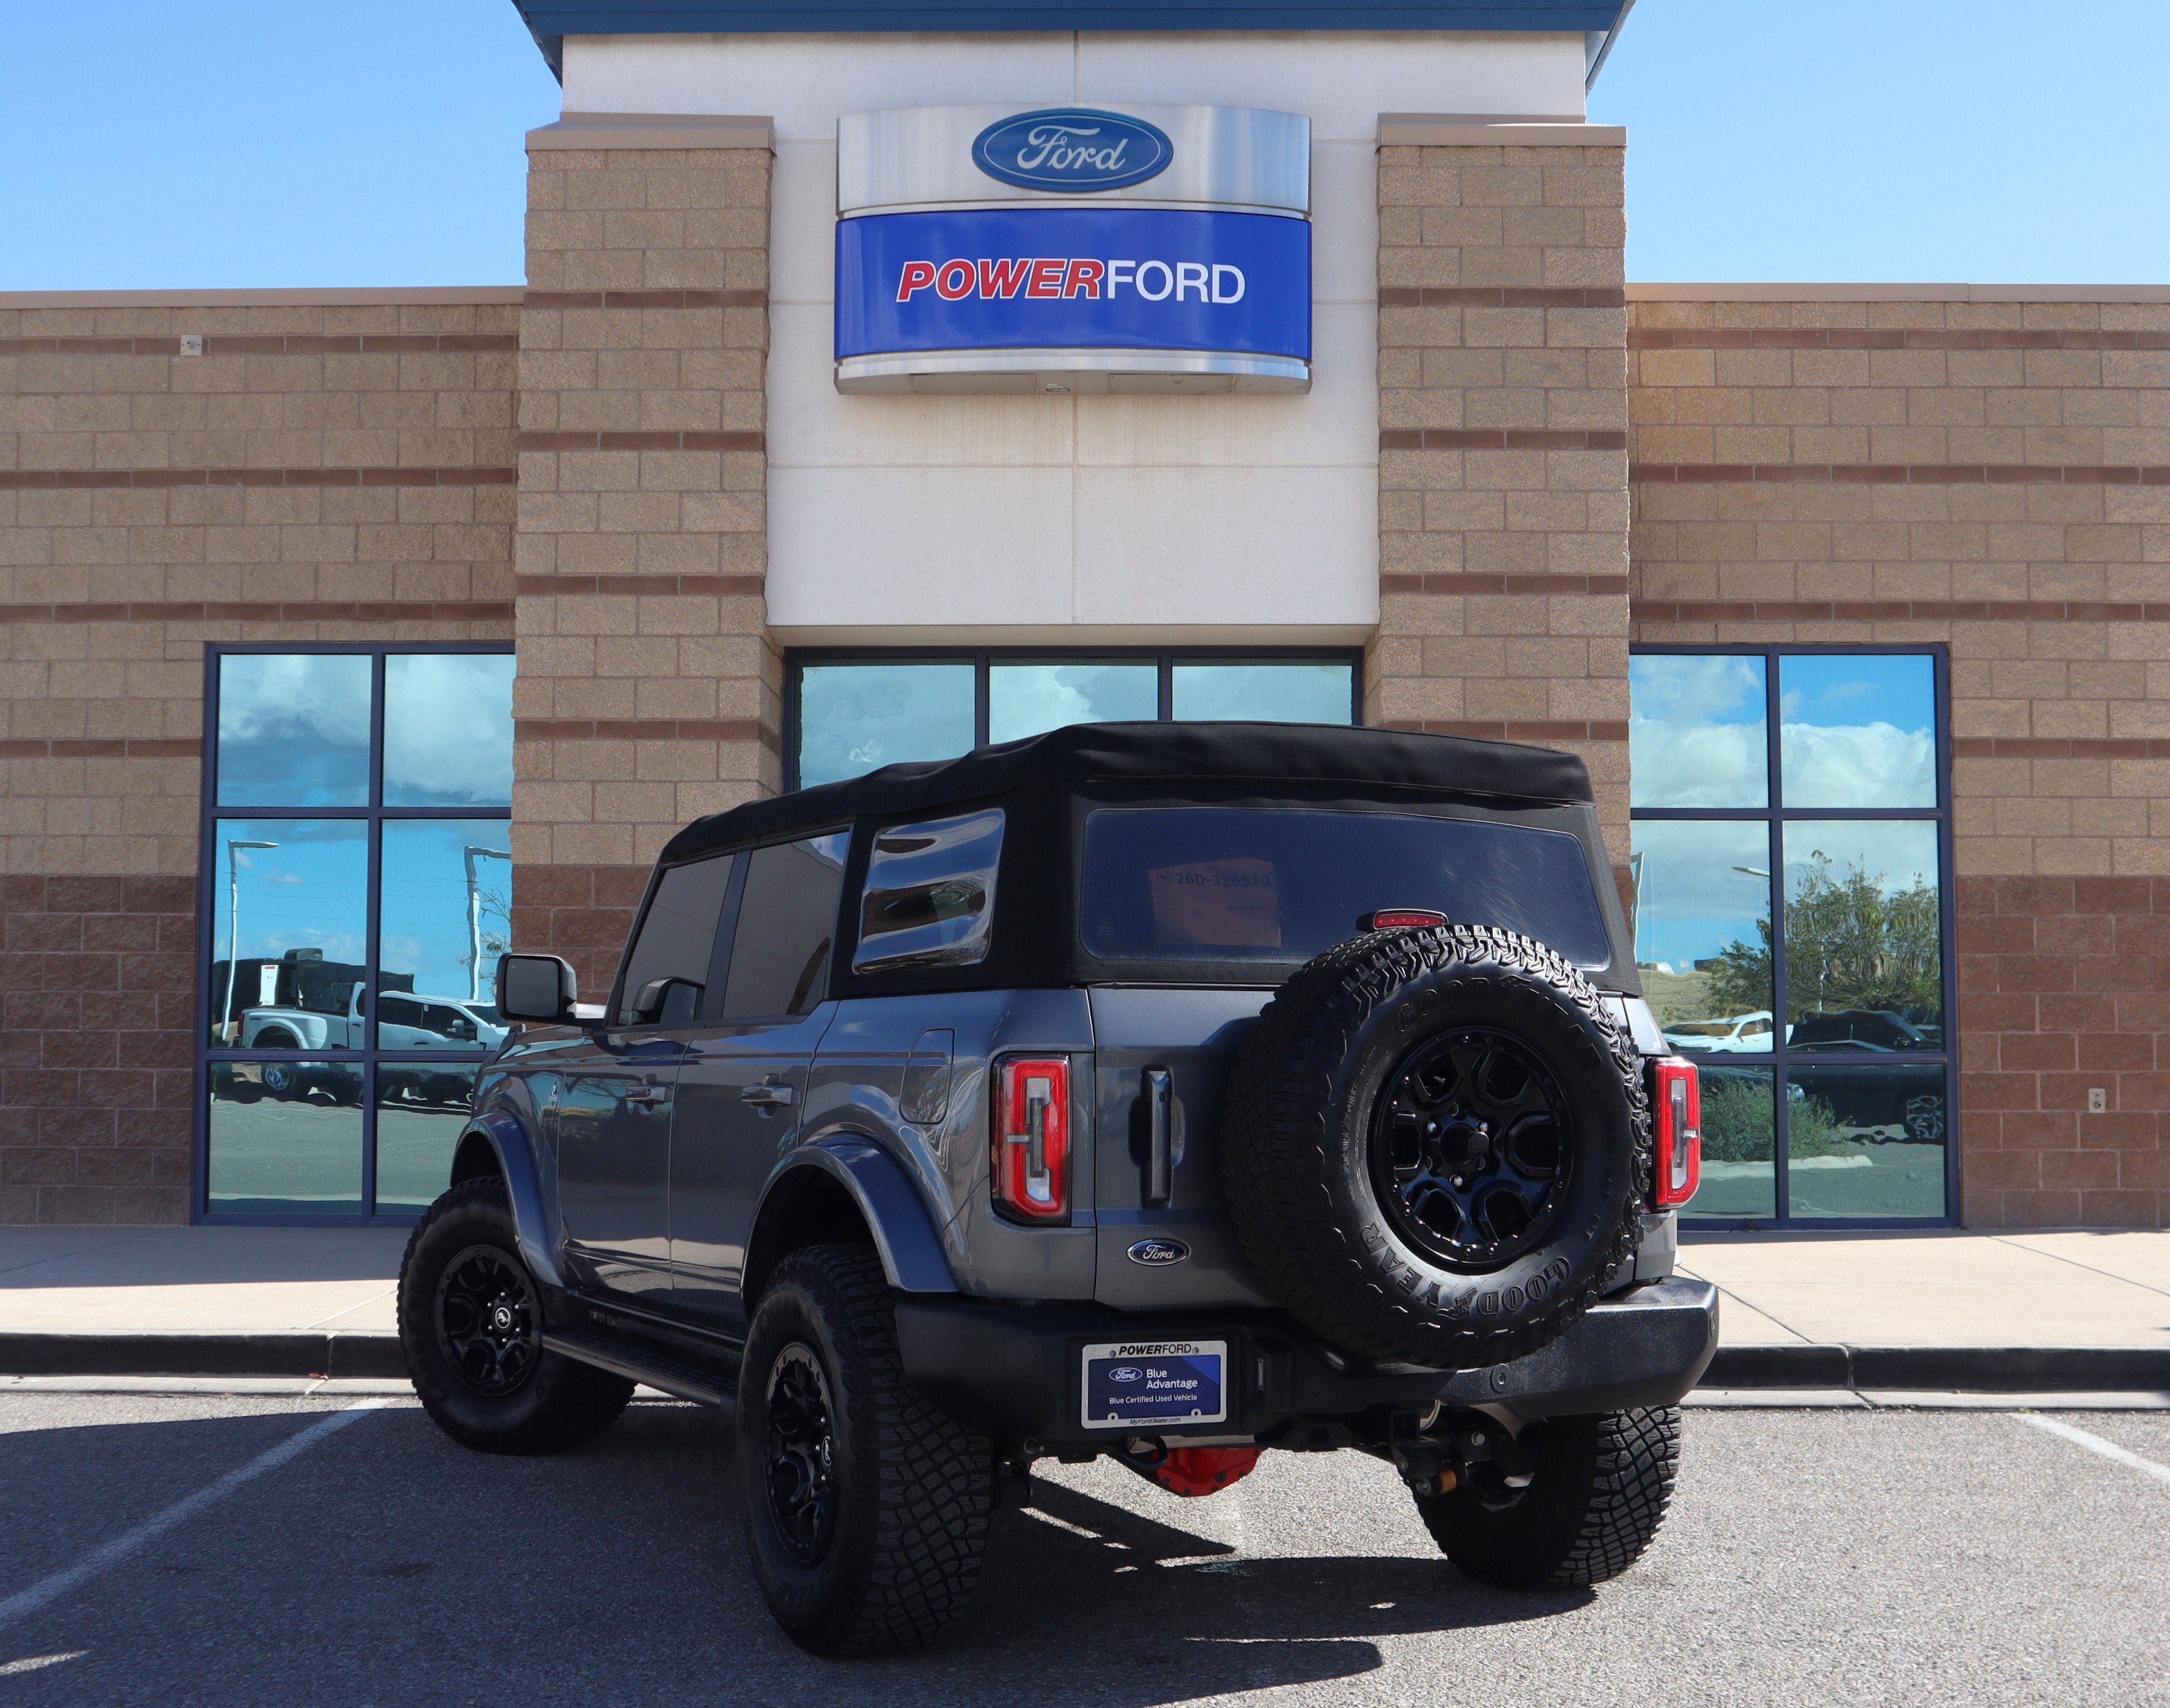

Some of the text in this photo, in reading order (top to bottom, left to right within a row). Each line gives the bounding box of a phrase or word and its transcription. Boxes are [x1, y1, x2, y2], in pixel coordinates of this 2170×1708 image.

[1016, 124, 1129, 170] Ford
[896, 258, 1246, 304] POWERFORD
[1143, 1244, 1174, 1259] Ford
[1360, 1222, 1571, 1319] GOODYEAR
[1118, 1344, 1192, 1355] POWERFORD
[1115, 1369, 1136, 1379] Ford
[1147, 1369, 1167, 1378] Blue
[1146, 1379, 1198, 1390] Advantage
[1125, 1396, 1154, 1404] Certified
[1129, 1417, 1181, 1425] MyFordDealer.com
